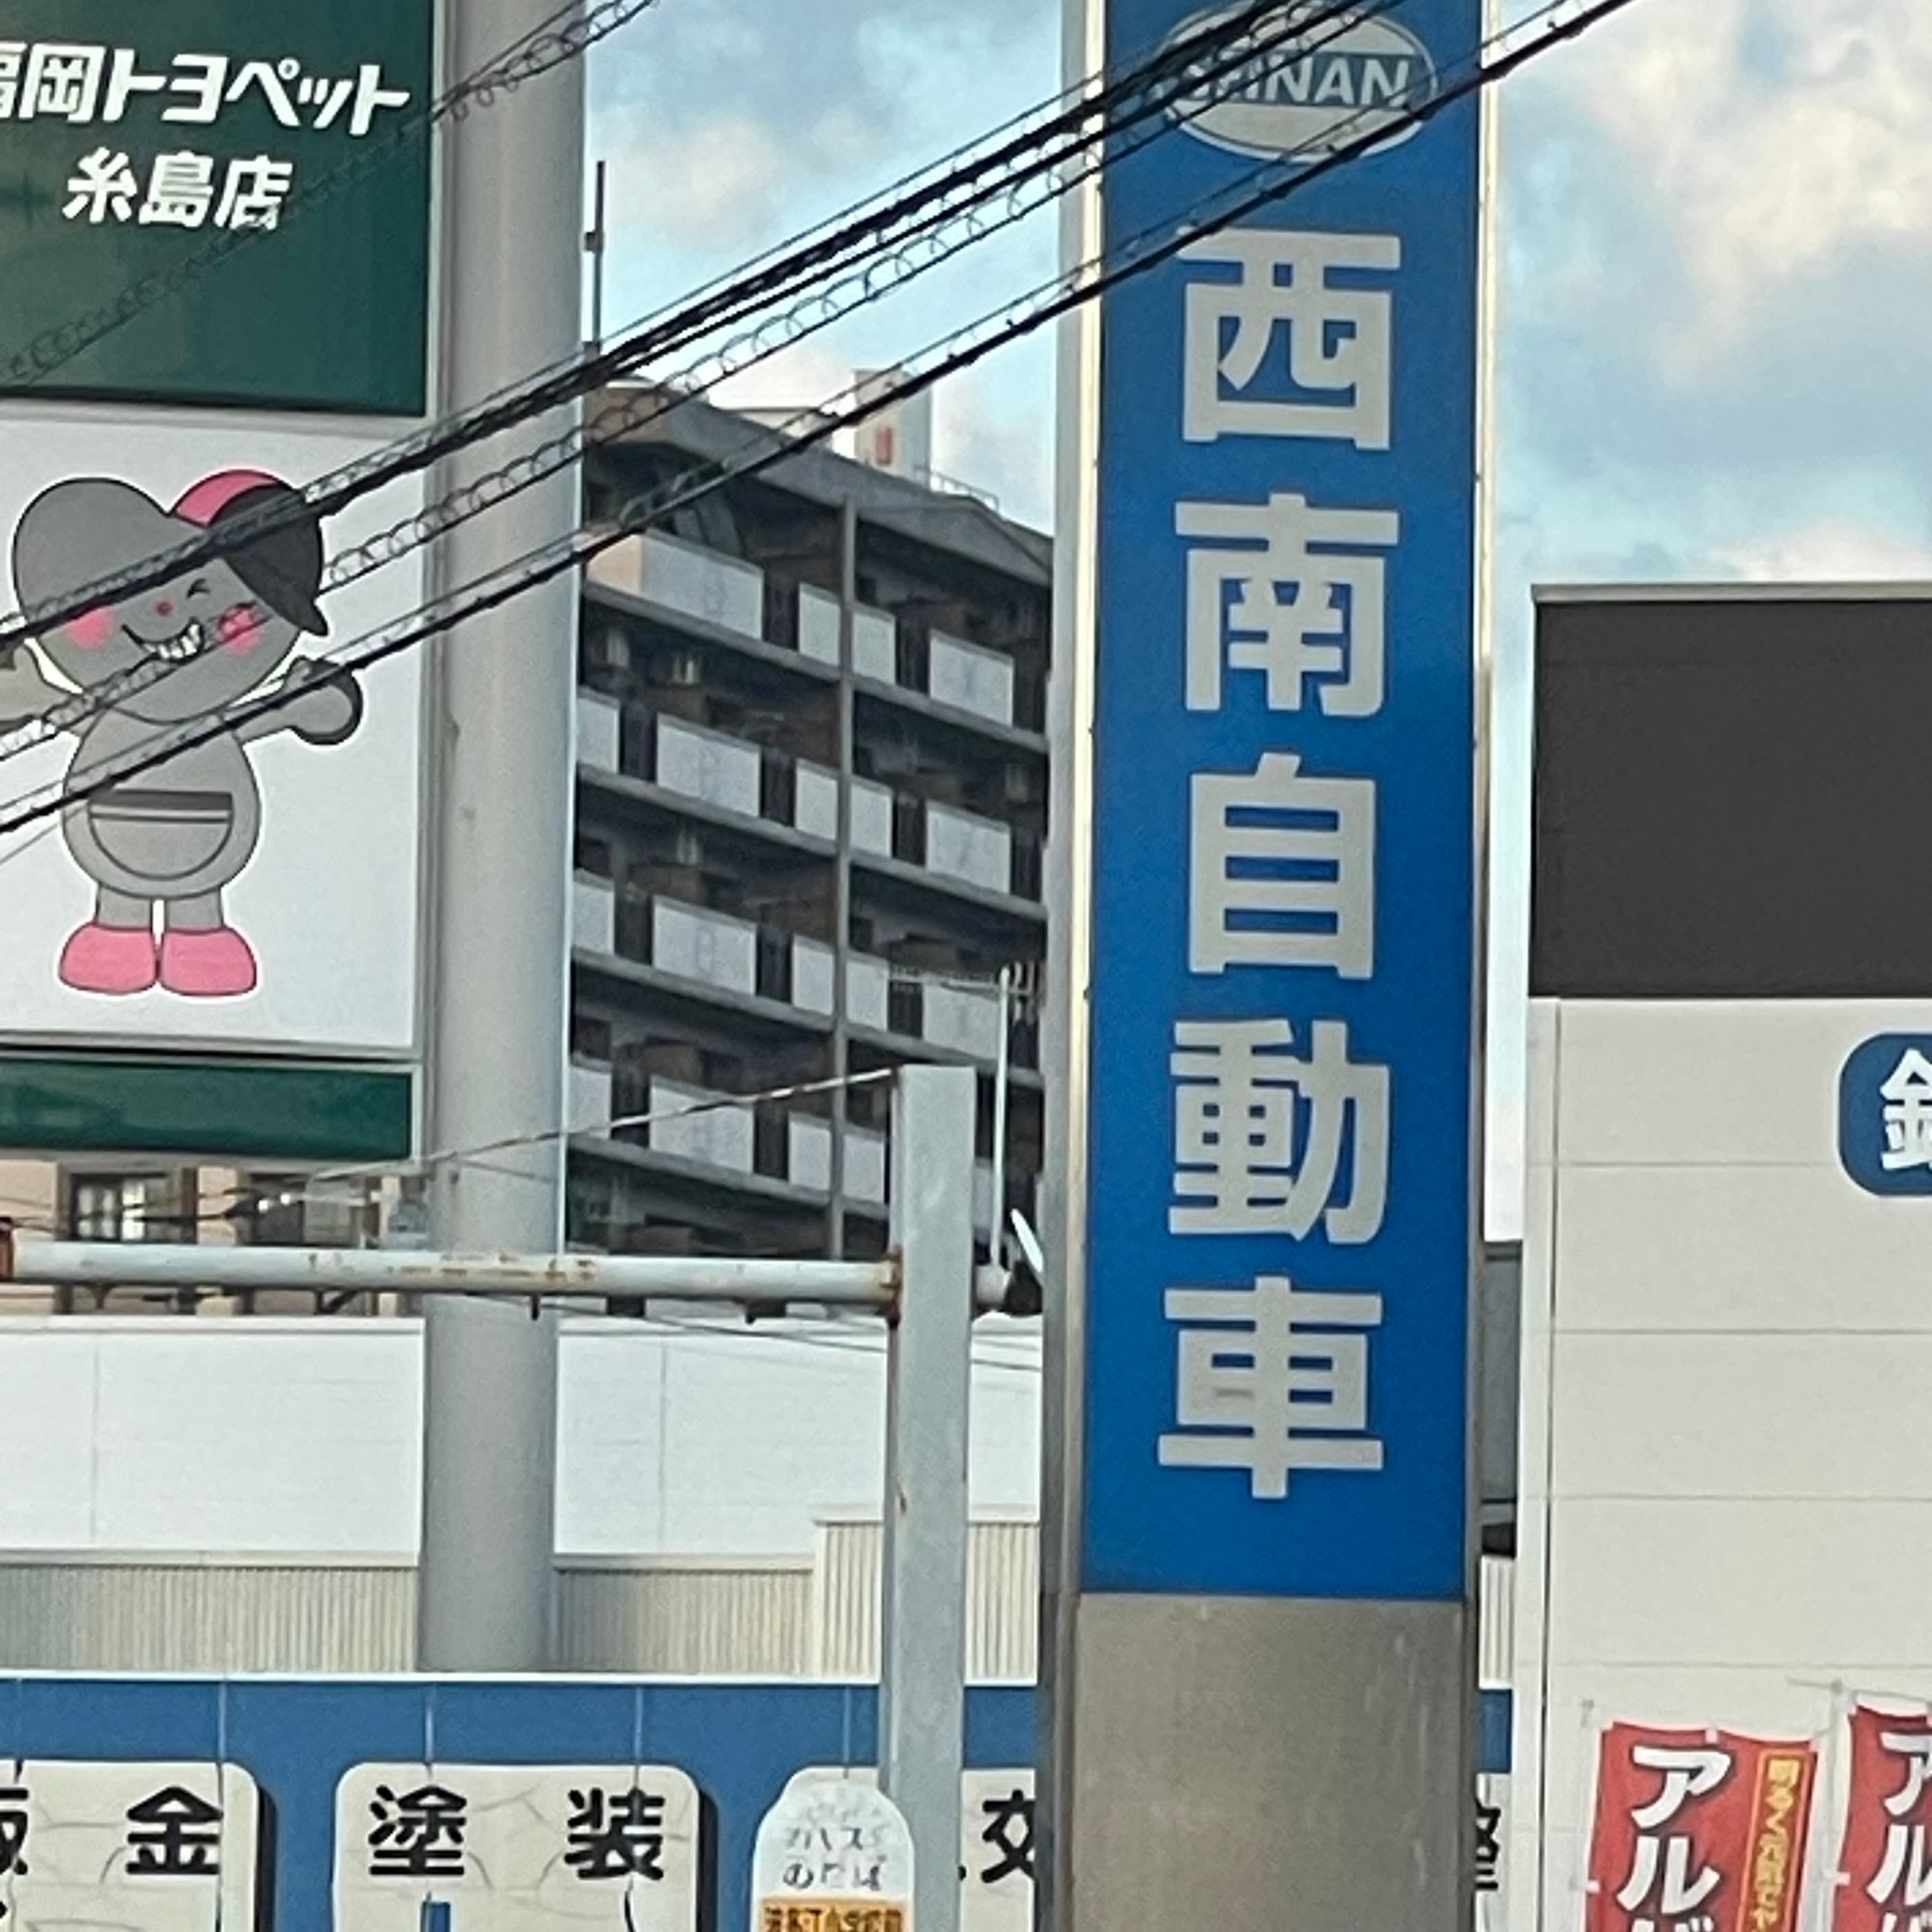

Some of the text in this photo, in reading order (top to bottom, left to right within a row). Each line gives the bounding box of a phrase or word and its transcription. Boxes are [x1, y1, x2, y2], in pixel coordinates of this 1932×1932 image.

[63, 146, 293, 231] 糸島店
[1157, 226, 1400, 1499] 西南自動車
[1617, 1745, 1731, 1932] アル
[1866, 1732, 1932, 1932] アル
